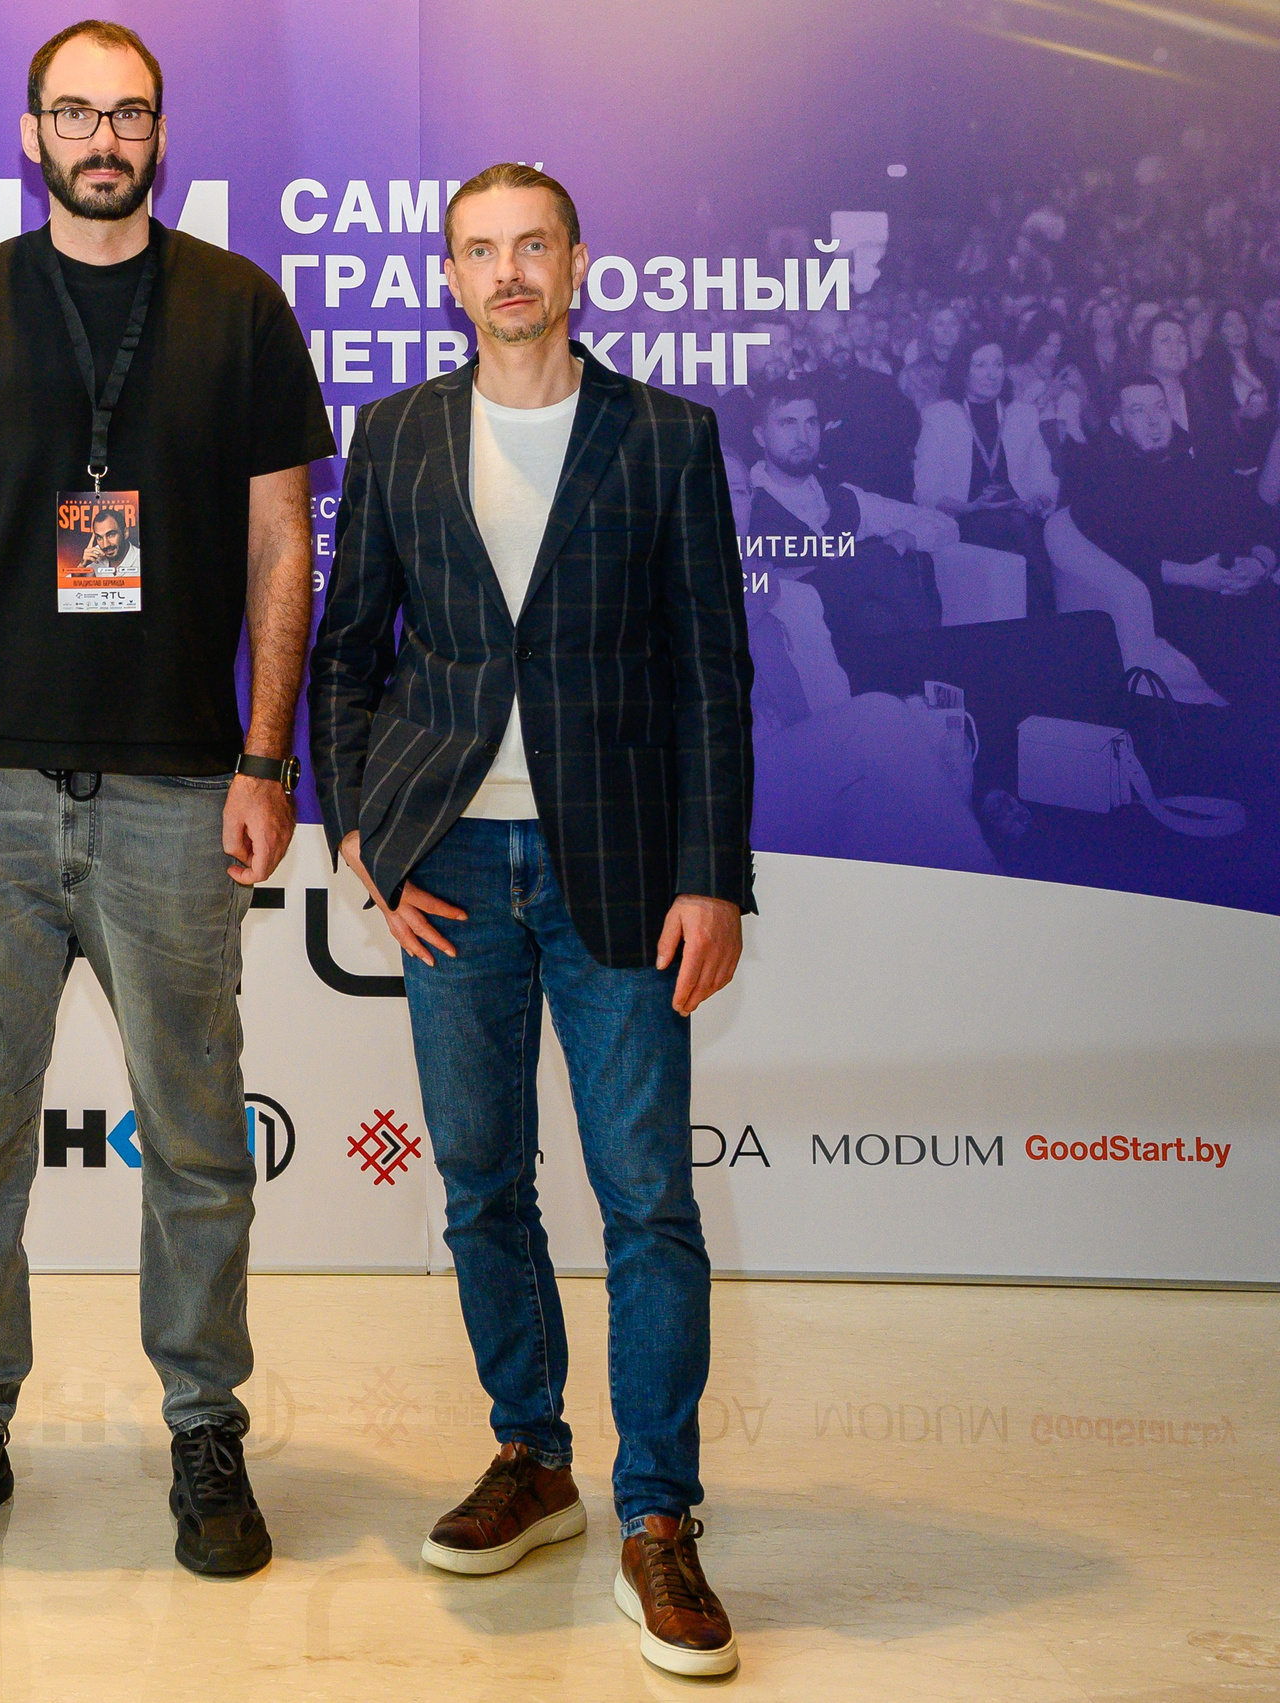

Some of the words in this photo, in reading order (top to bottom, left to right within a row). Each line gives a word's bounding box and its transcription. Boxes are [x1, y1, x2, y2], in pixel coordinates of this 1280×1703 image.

[281, 238, 850, 312] ГРАНОЗНЫЙ
[812, 1134, 1004, 1166] MODUM
[1025, 1134, 1231, 1168] GoodStart.by
